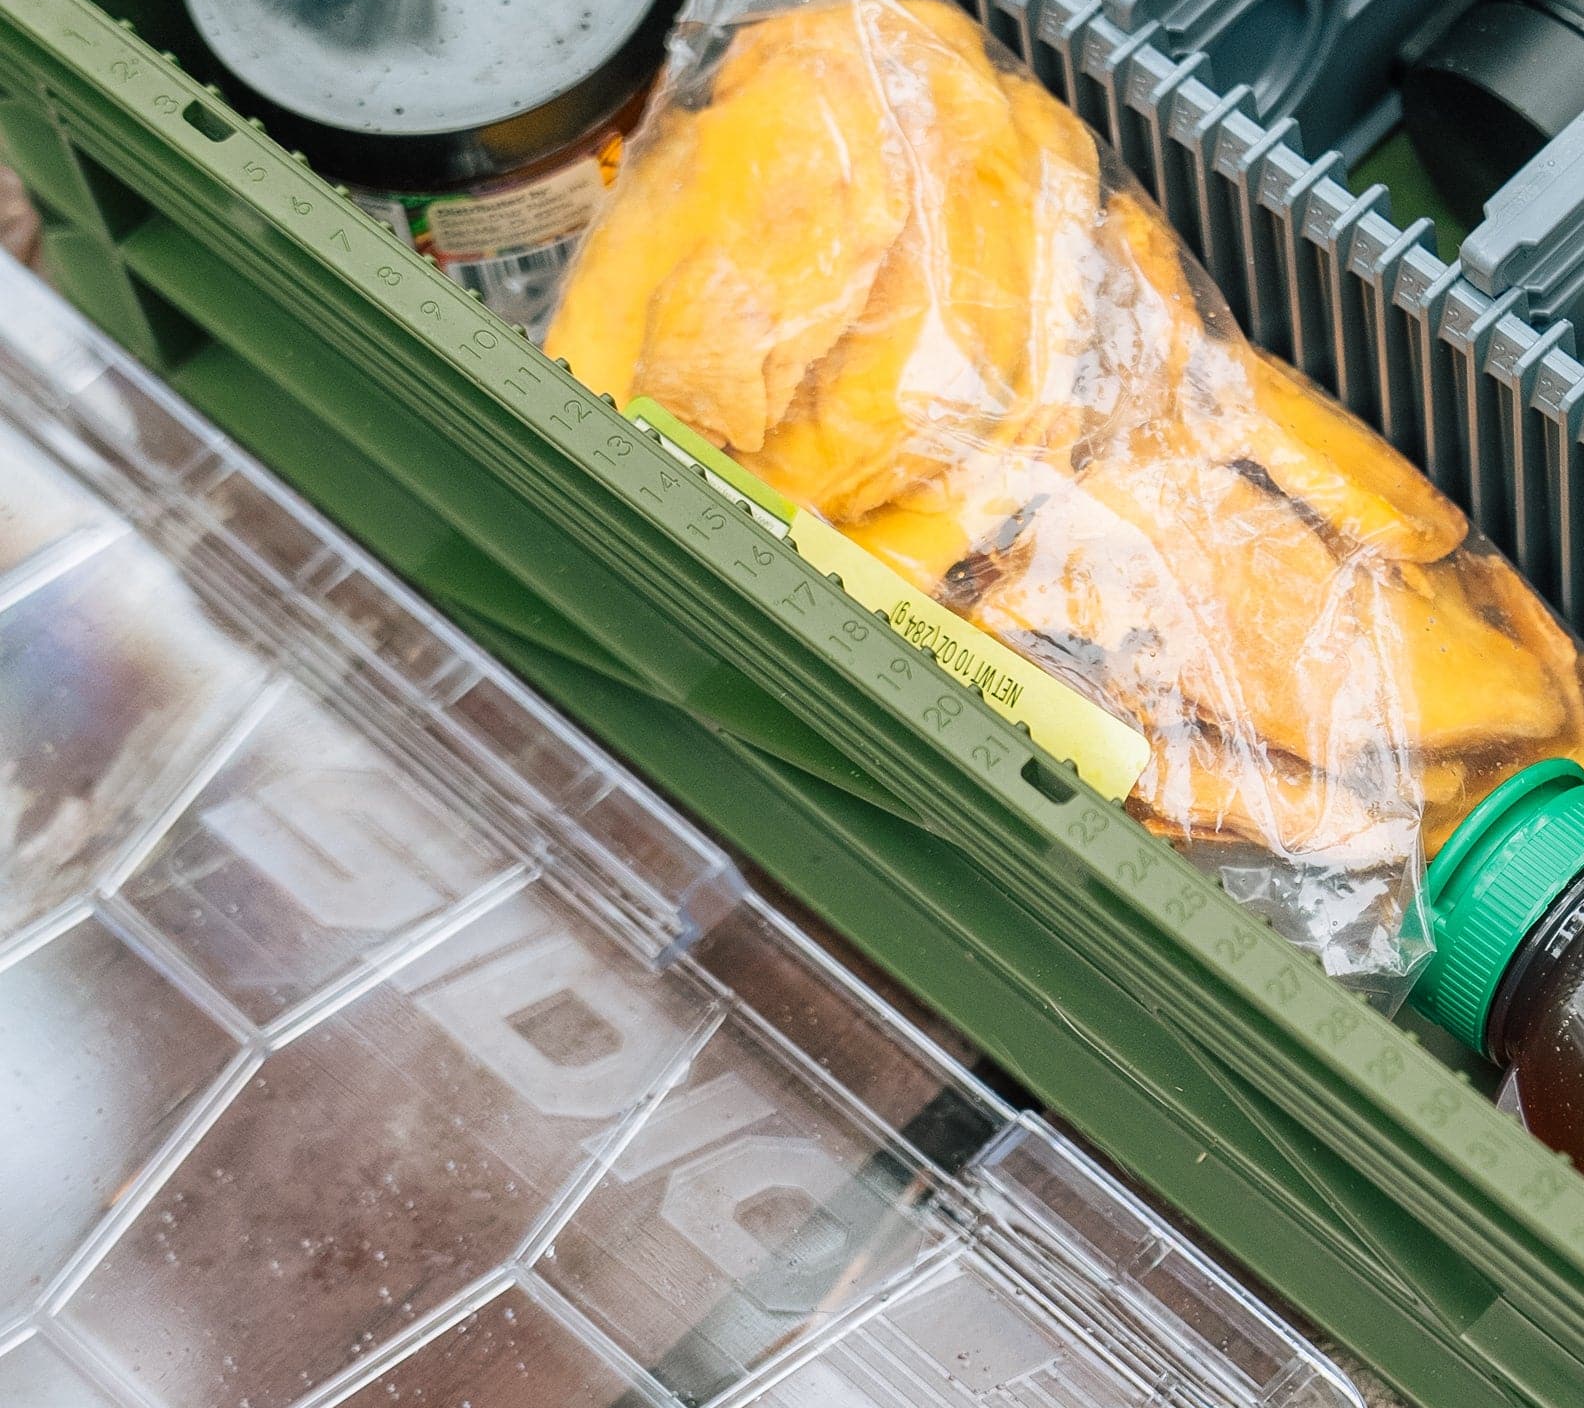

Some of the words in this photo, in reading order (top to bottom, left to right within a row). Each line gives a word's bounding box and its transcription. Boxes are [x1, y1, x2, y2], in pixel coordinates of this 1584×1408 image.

[930, 635, 957, 664] OZ
[951, 648, 974, 675] 10
[970, 661, 996, 691] WT
[991, 675, 1024, 707] NET
